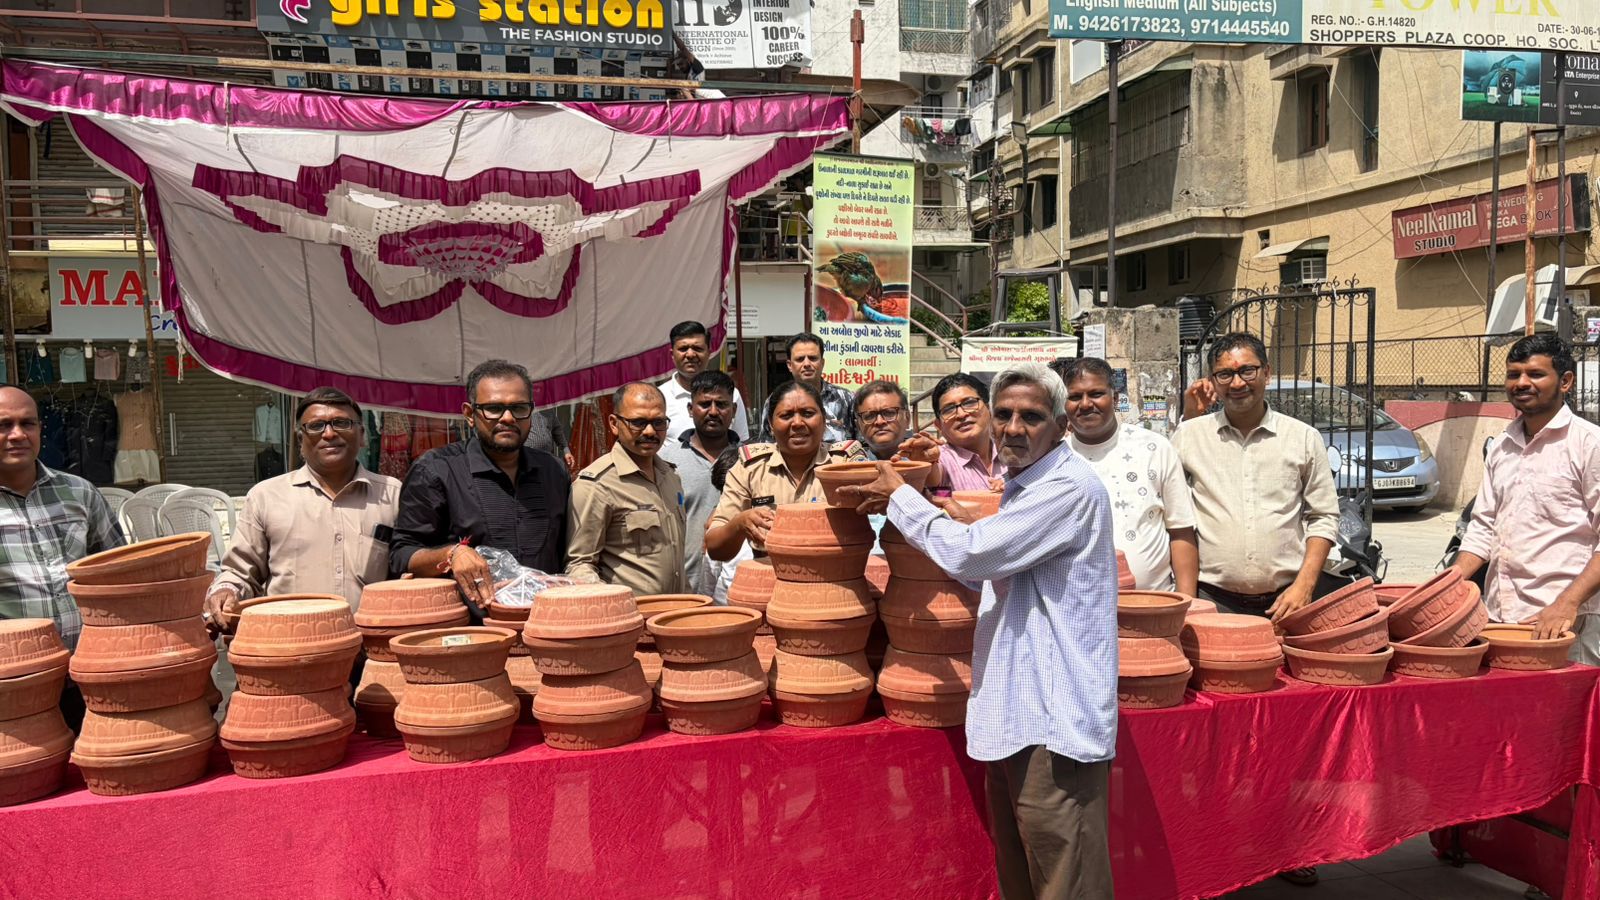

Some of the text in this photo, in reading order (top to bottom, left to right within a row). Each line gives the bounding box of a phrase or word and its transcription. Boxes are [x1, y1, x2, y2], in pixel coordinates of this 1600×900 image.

[1127, 0, 1179, 10] Medium
[1211, 0, 1277, 16] Subjects)
[754, 11, 783, 22] DESIGN
[1311, 15, 1336, 25] REG.
[1367, 16, 1416, 27] G.H.14820
[762, 26, 805, 40] 100%
[1053, 15, 1290, 37] M. 9426173823, 9714445540
[499, 27, 663, 46] THE FASHION STUDIO
[1310, 29, 1396, 42] SHOPPERS
[1405, 31, 1456, 44] PLAZA
[1463, 33, 1508, 46] COOP.
[1516, 35, 1541, 48] HO.
[1549, 37, 1583, 49] SOC.
[768, 41, 800, 53] CAREER
[766, 52, 804, 66] SUCCESS
[1520, 209, 1552, 224] BOK
[1414, 234, 1456, 251] STUDIO
[819, 326, 829, 336] આ
